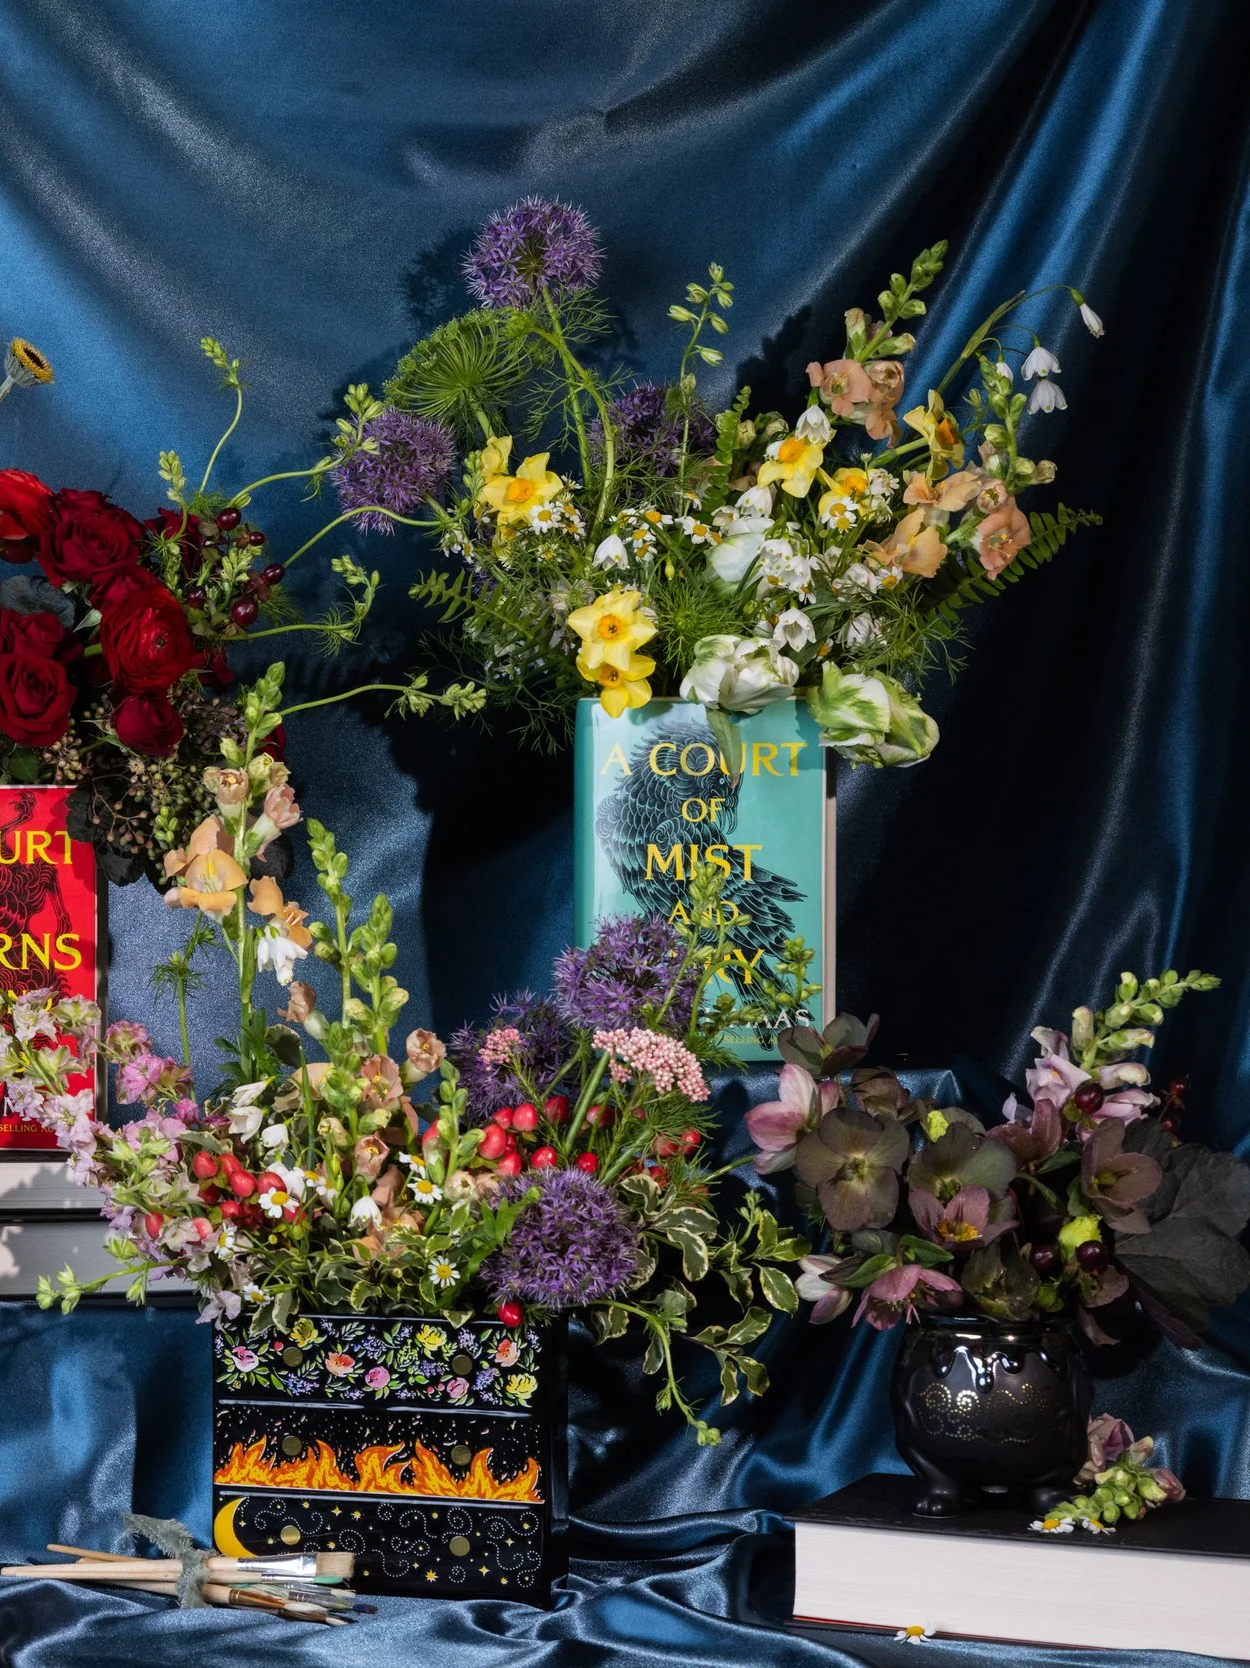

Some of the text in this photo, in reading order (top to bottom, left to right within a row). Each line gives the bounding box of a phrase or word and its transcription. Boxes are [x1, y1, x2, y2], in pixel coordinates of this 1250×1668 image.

[601, 742, 632, 776] A
[682, 797, 726, 822] OF
[644, 844, 763, 881] MIST
